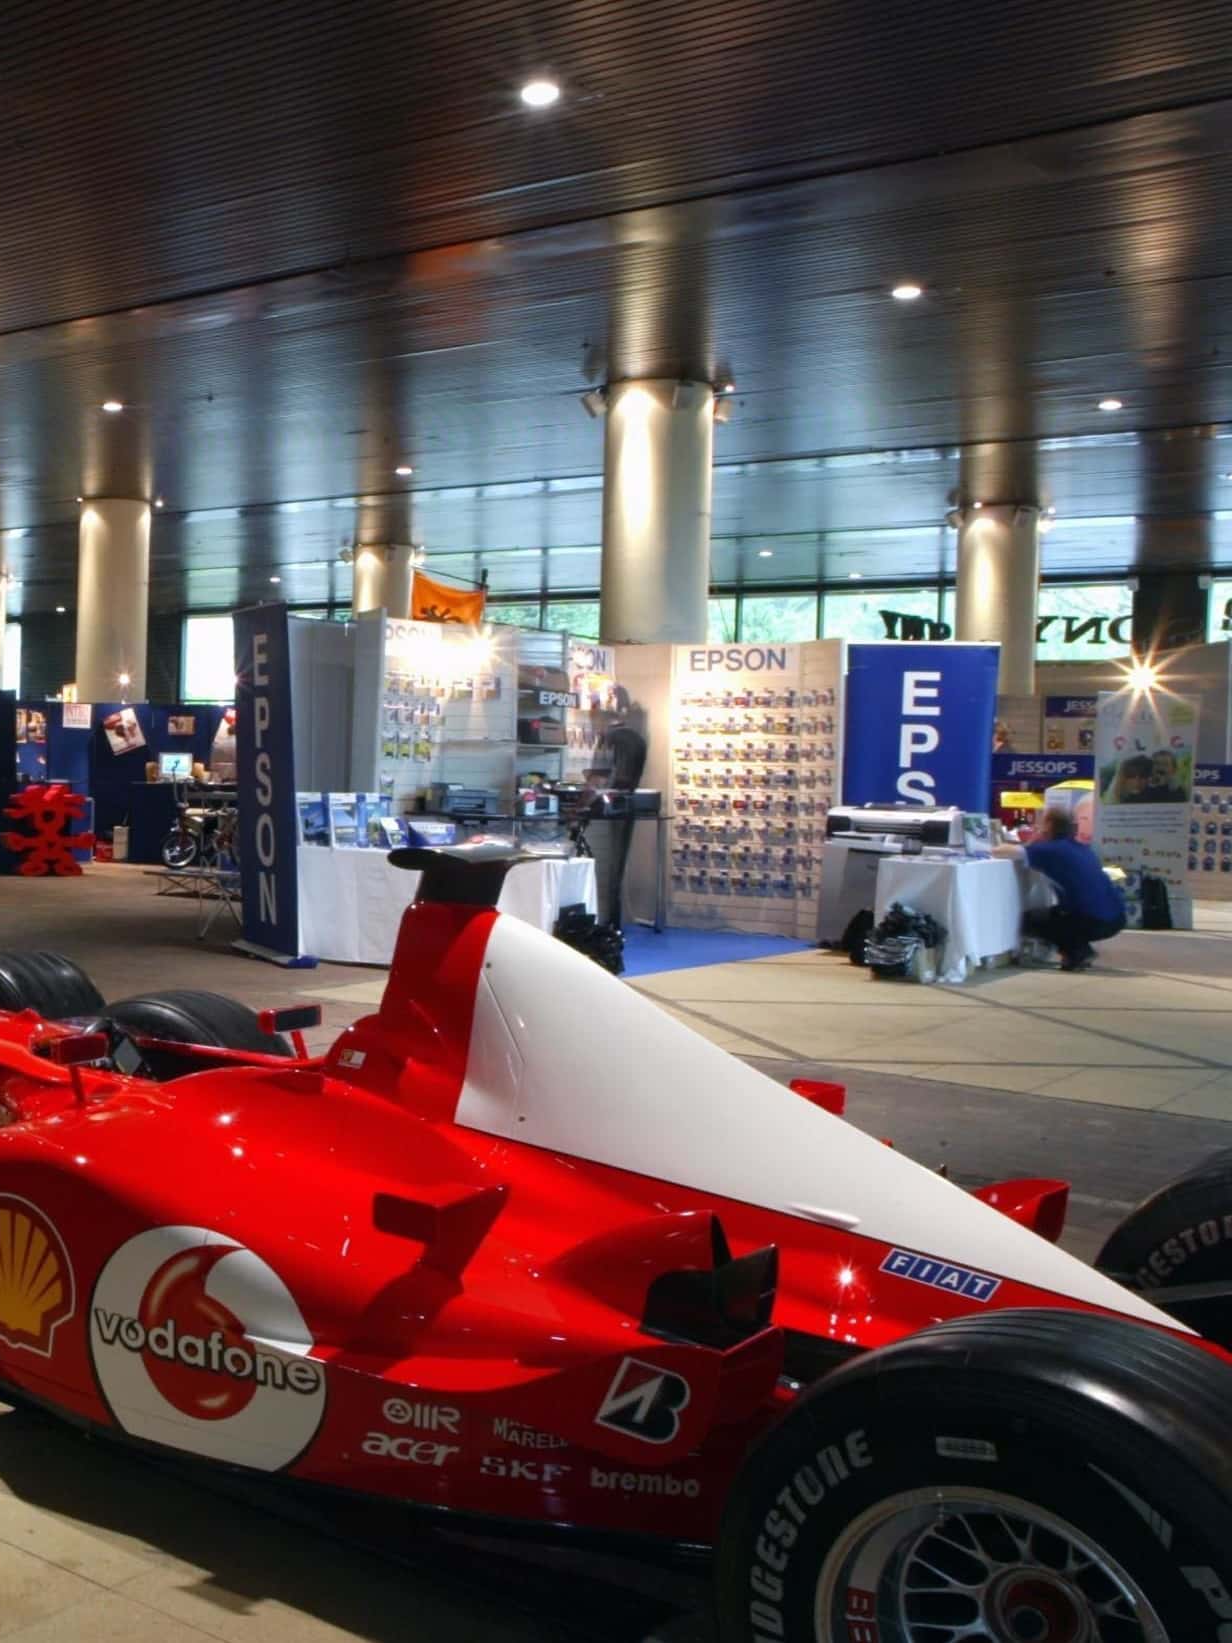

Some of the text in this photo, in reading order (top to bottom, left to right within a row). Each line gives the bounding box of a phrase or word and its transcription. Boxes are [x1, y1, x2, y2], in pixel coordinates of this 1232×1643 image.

[690, 647, 787, 672] EPSON
[539, 691, 577, 707] EPSON
[251, 633, 279, 926] EPSON
[1007, 760, 1078, 776] JESSOPS
[887, 1254, 994, 1297] FIAT
[94, 1308, 322, 1394] vodafone
[361, 1432, 461, 1468] acer
[479, 1455, 574, 1483] SKF
[590, 1466, 700, 1497] brembo
